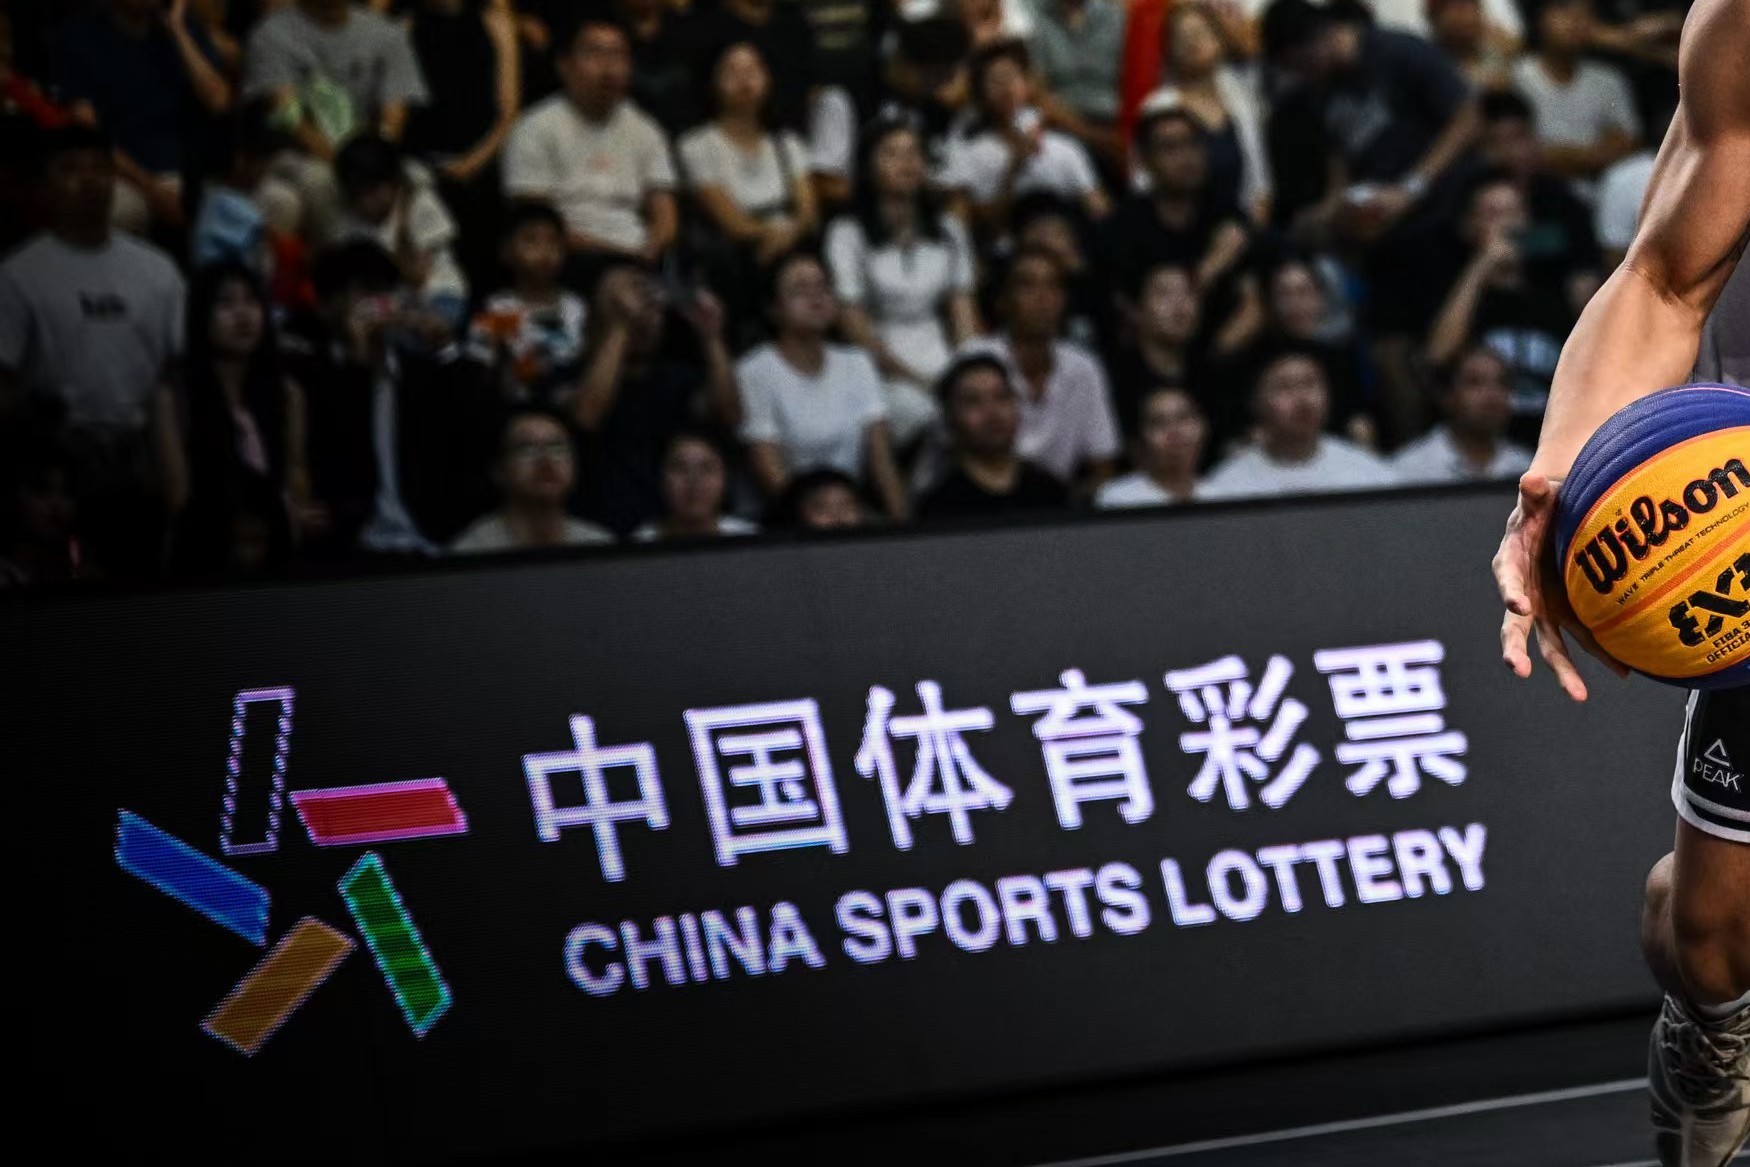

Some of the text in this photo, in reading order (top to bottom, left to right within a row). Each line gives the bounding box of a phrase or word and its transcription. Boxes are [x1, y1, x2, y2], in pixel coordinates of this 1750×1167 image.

[1616, 501, 1750, 607] WAVE TRIPLE THREAT TECHNOLOGY
[1712, 627, 1743, 649] FIBA
[521, 638, 1470, 882] 中国体育彩票
[1693, 757, 1740, 791] PEAK
[563, 821, 1488, 995] CHINA SPORTS LOTTERY
